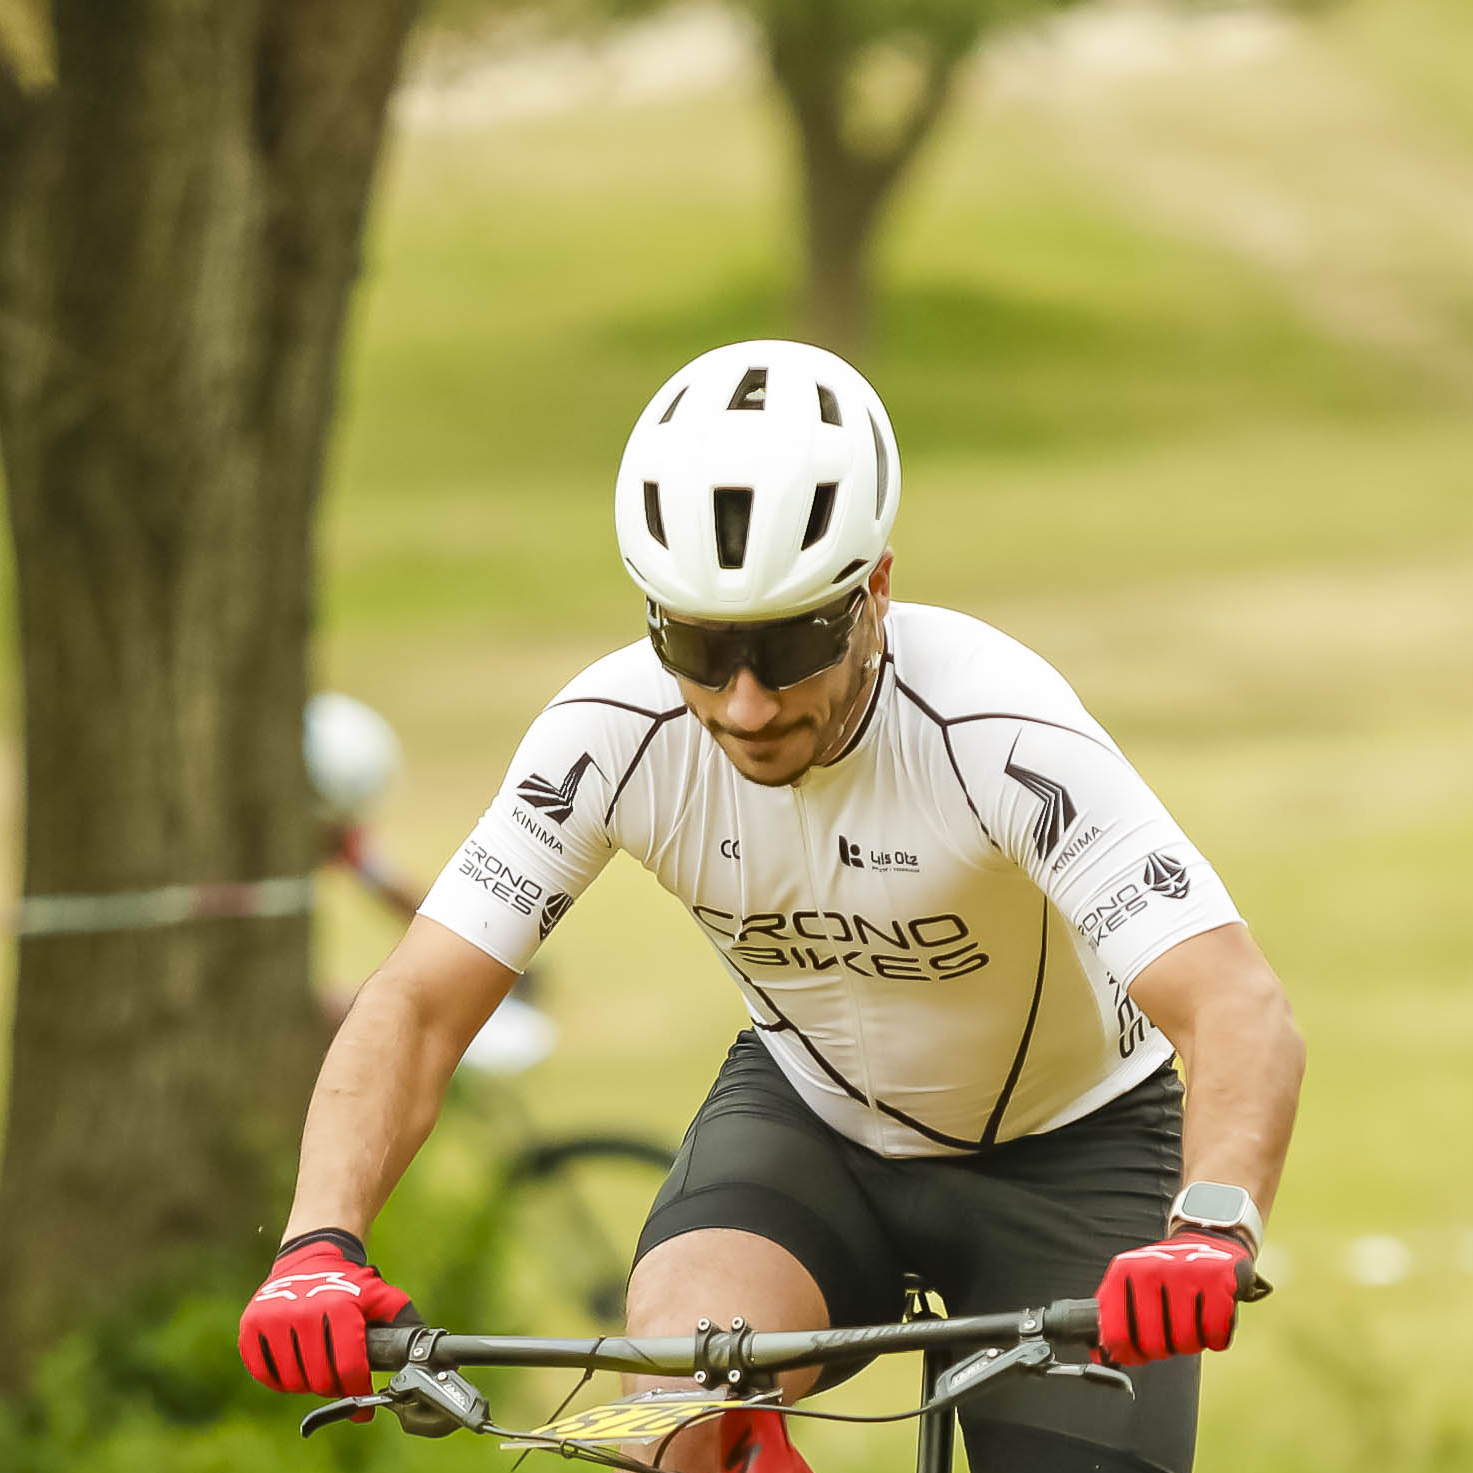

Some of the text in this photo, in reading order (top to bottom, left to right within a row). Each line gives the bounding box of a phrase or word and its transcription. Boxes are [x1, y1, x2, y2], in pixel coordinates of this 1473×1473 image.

[512, 806, 564, 855] KINIMA
[1051, 826, 1103, 874] KINIMA
[459, 858, 536, 916] BIKES
[464, 840, 543, 900] CRONO
[692, 905, 970, 950] CRONO
[1077, 884, 1139, 937] RONO
[731, 941, 990, 982] BIKES
